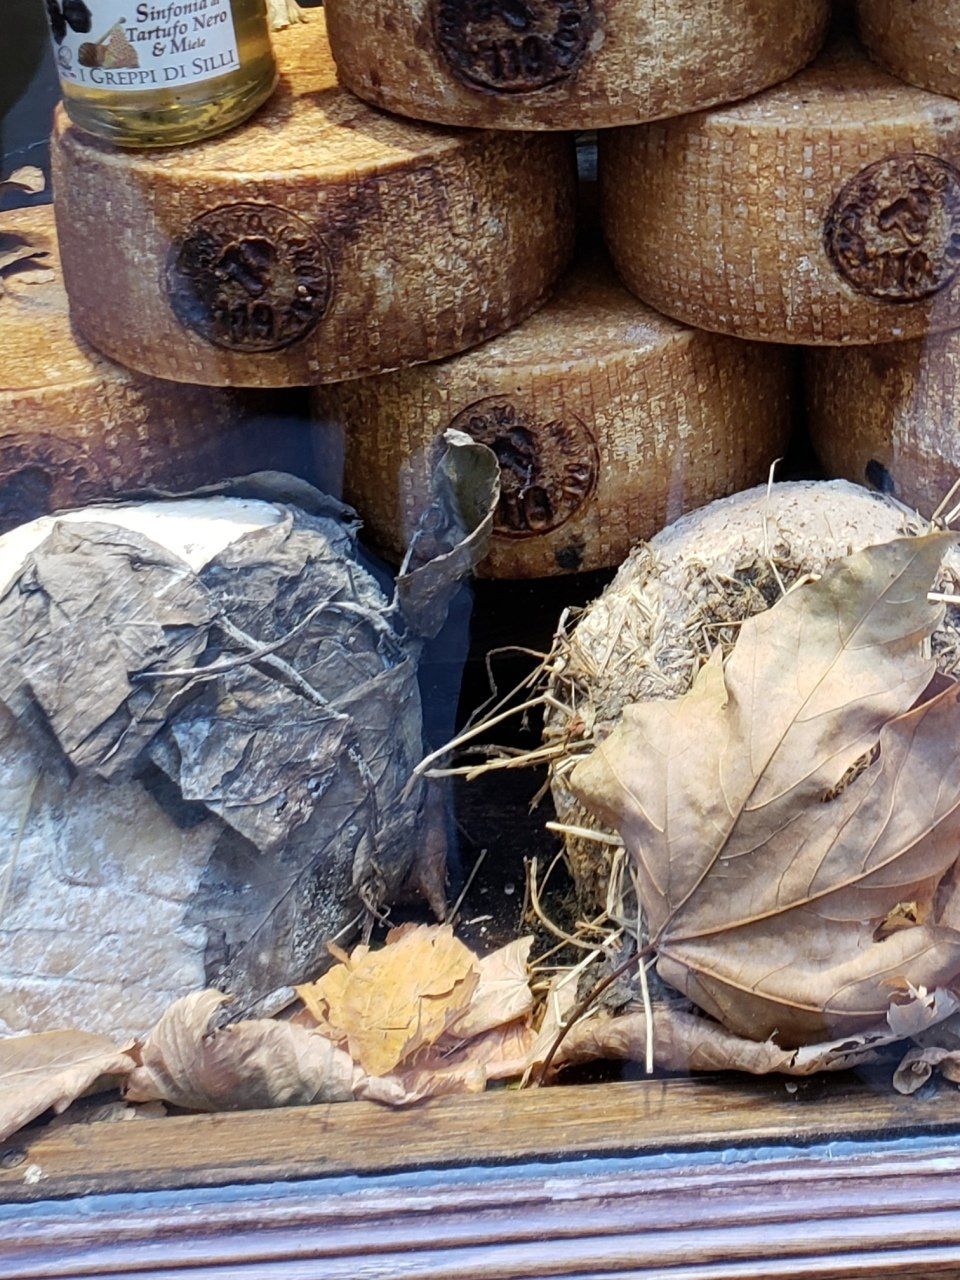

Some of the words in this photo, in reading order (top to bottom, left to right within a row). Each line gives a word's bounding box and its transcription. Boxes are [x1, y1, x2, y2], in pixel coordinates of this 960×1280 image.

[126, 19, 189, 43] Tartufo
[192, 9, 228, 32] Nero
[152, 40, 166, 57] &
[170, 35, 207, 55] Miele
[80, 68, 86, 82] I
[89, 68, 157, 86] GREPPI
[164, 64, 186, 82] DI
[192, 49, 236, 76] SILLI
